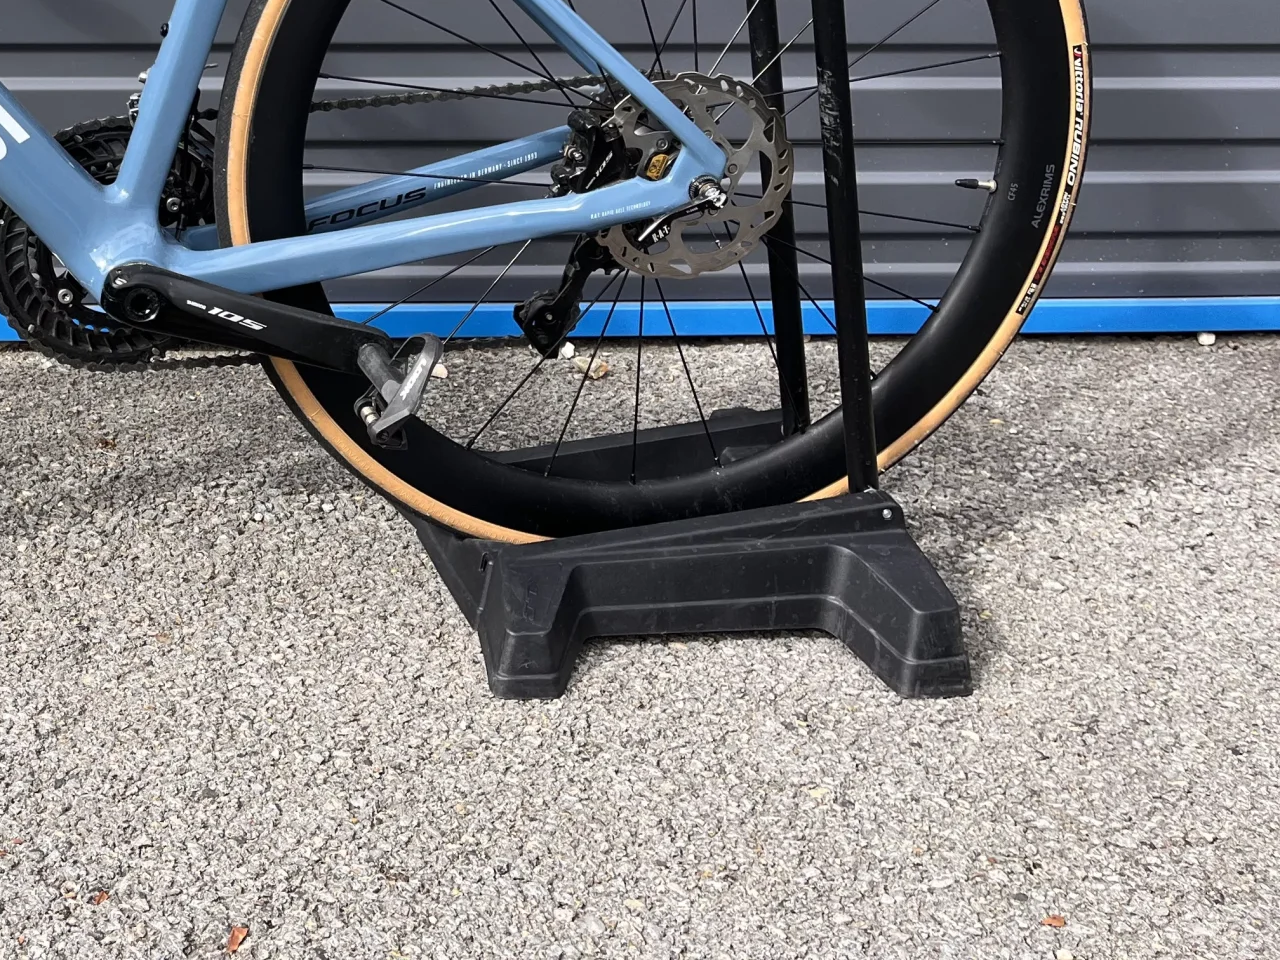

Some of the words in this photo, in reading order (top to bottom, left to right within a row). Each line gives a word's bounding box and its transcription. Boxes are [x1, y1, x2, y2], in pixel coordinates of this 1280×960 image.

[477, 163, 503, 177] GERMANY
[507, 156, 523, 168] SINCE
[524, 151, 538, 163] 1993
[1066, 116, 1084, 187] RUBINO
[306, 187, 427, 233] FOCUS
[1007, 183, 1019, 201] CF45
[1031, 164, 1056, 228] ALEXRIMS
[207, 306, 268, 331] 105
